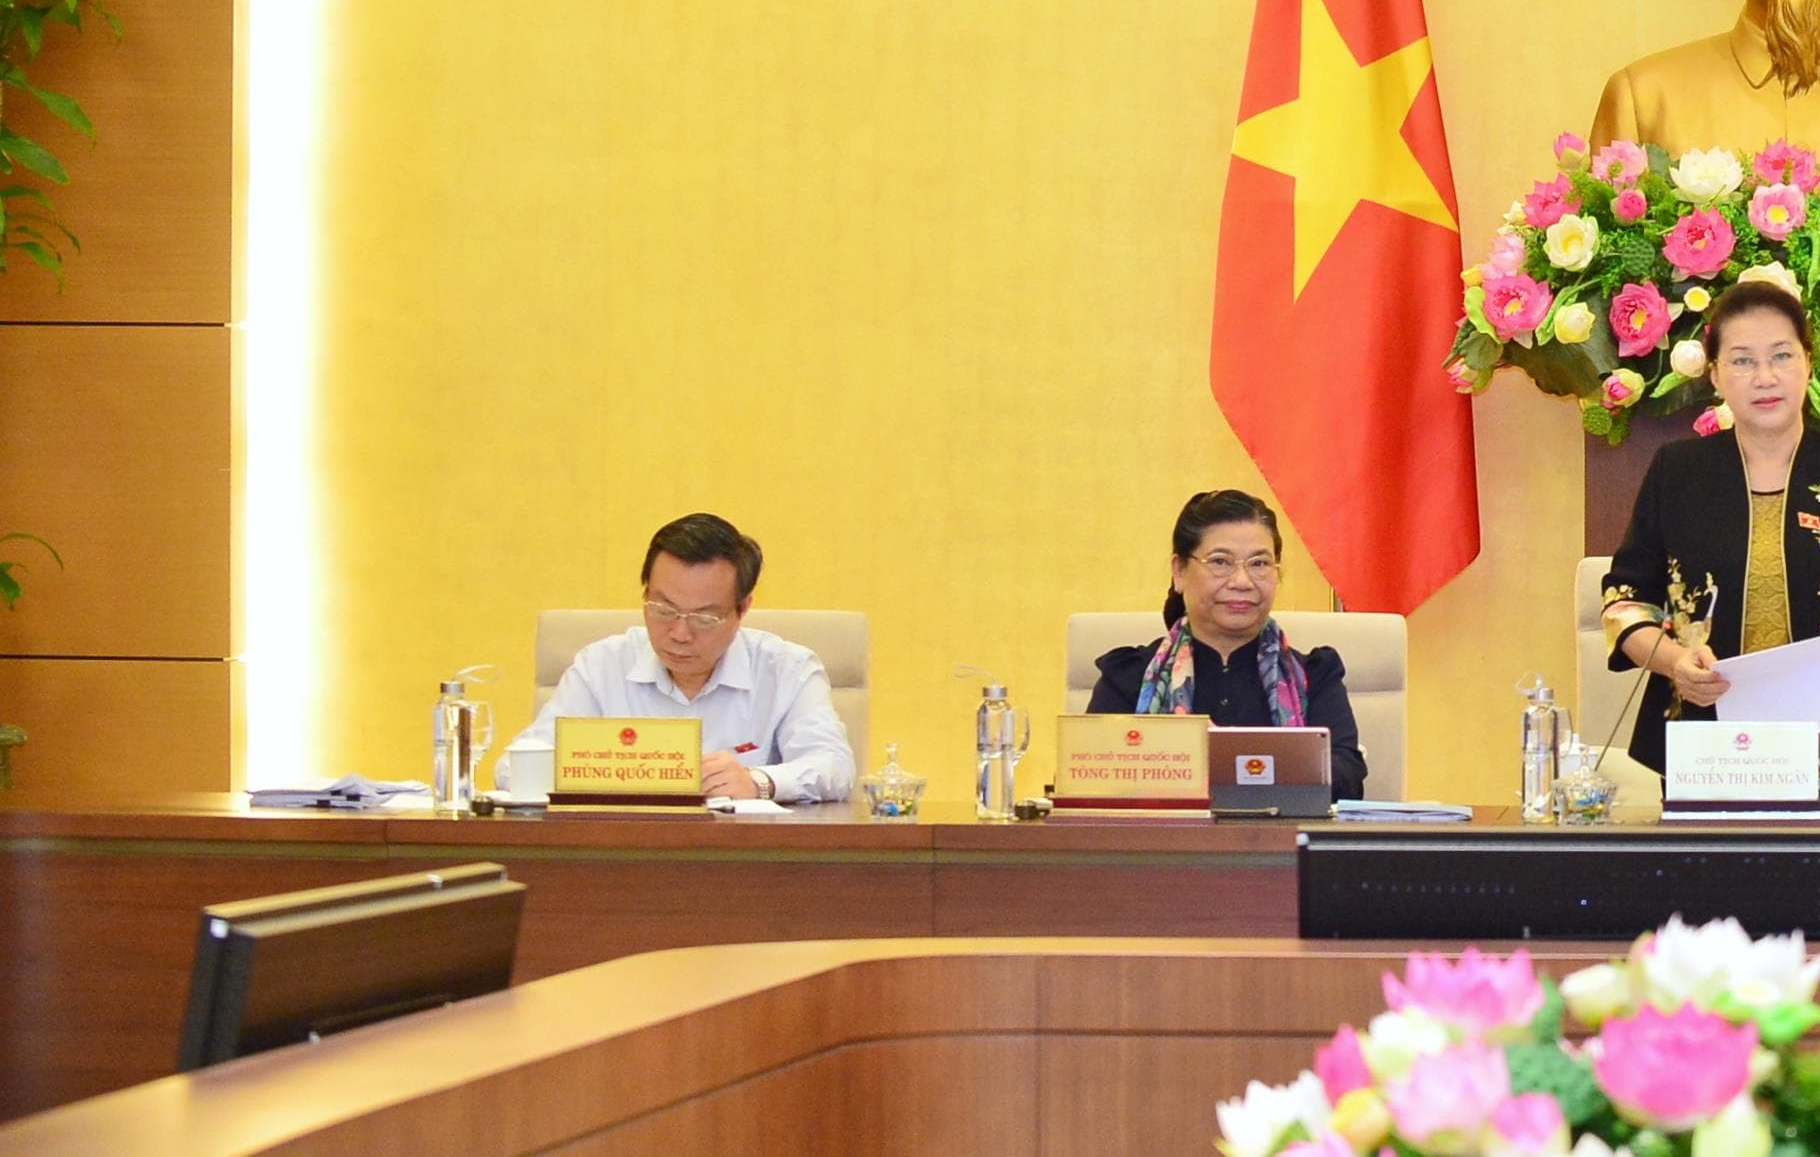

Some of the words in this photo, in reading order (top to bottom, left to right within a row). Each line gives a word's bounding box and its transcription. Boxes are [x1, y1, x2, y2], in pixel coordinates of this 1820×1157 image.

[563, 764, 611, 779] PHÙNG
[616, 763, 655, 781] QUỐC
[1113, 768, 1137, 781] THỊ
[1728, 773, 1747, 787] THỊ
[1751, 773, 1773, 784] KIM
